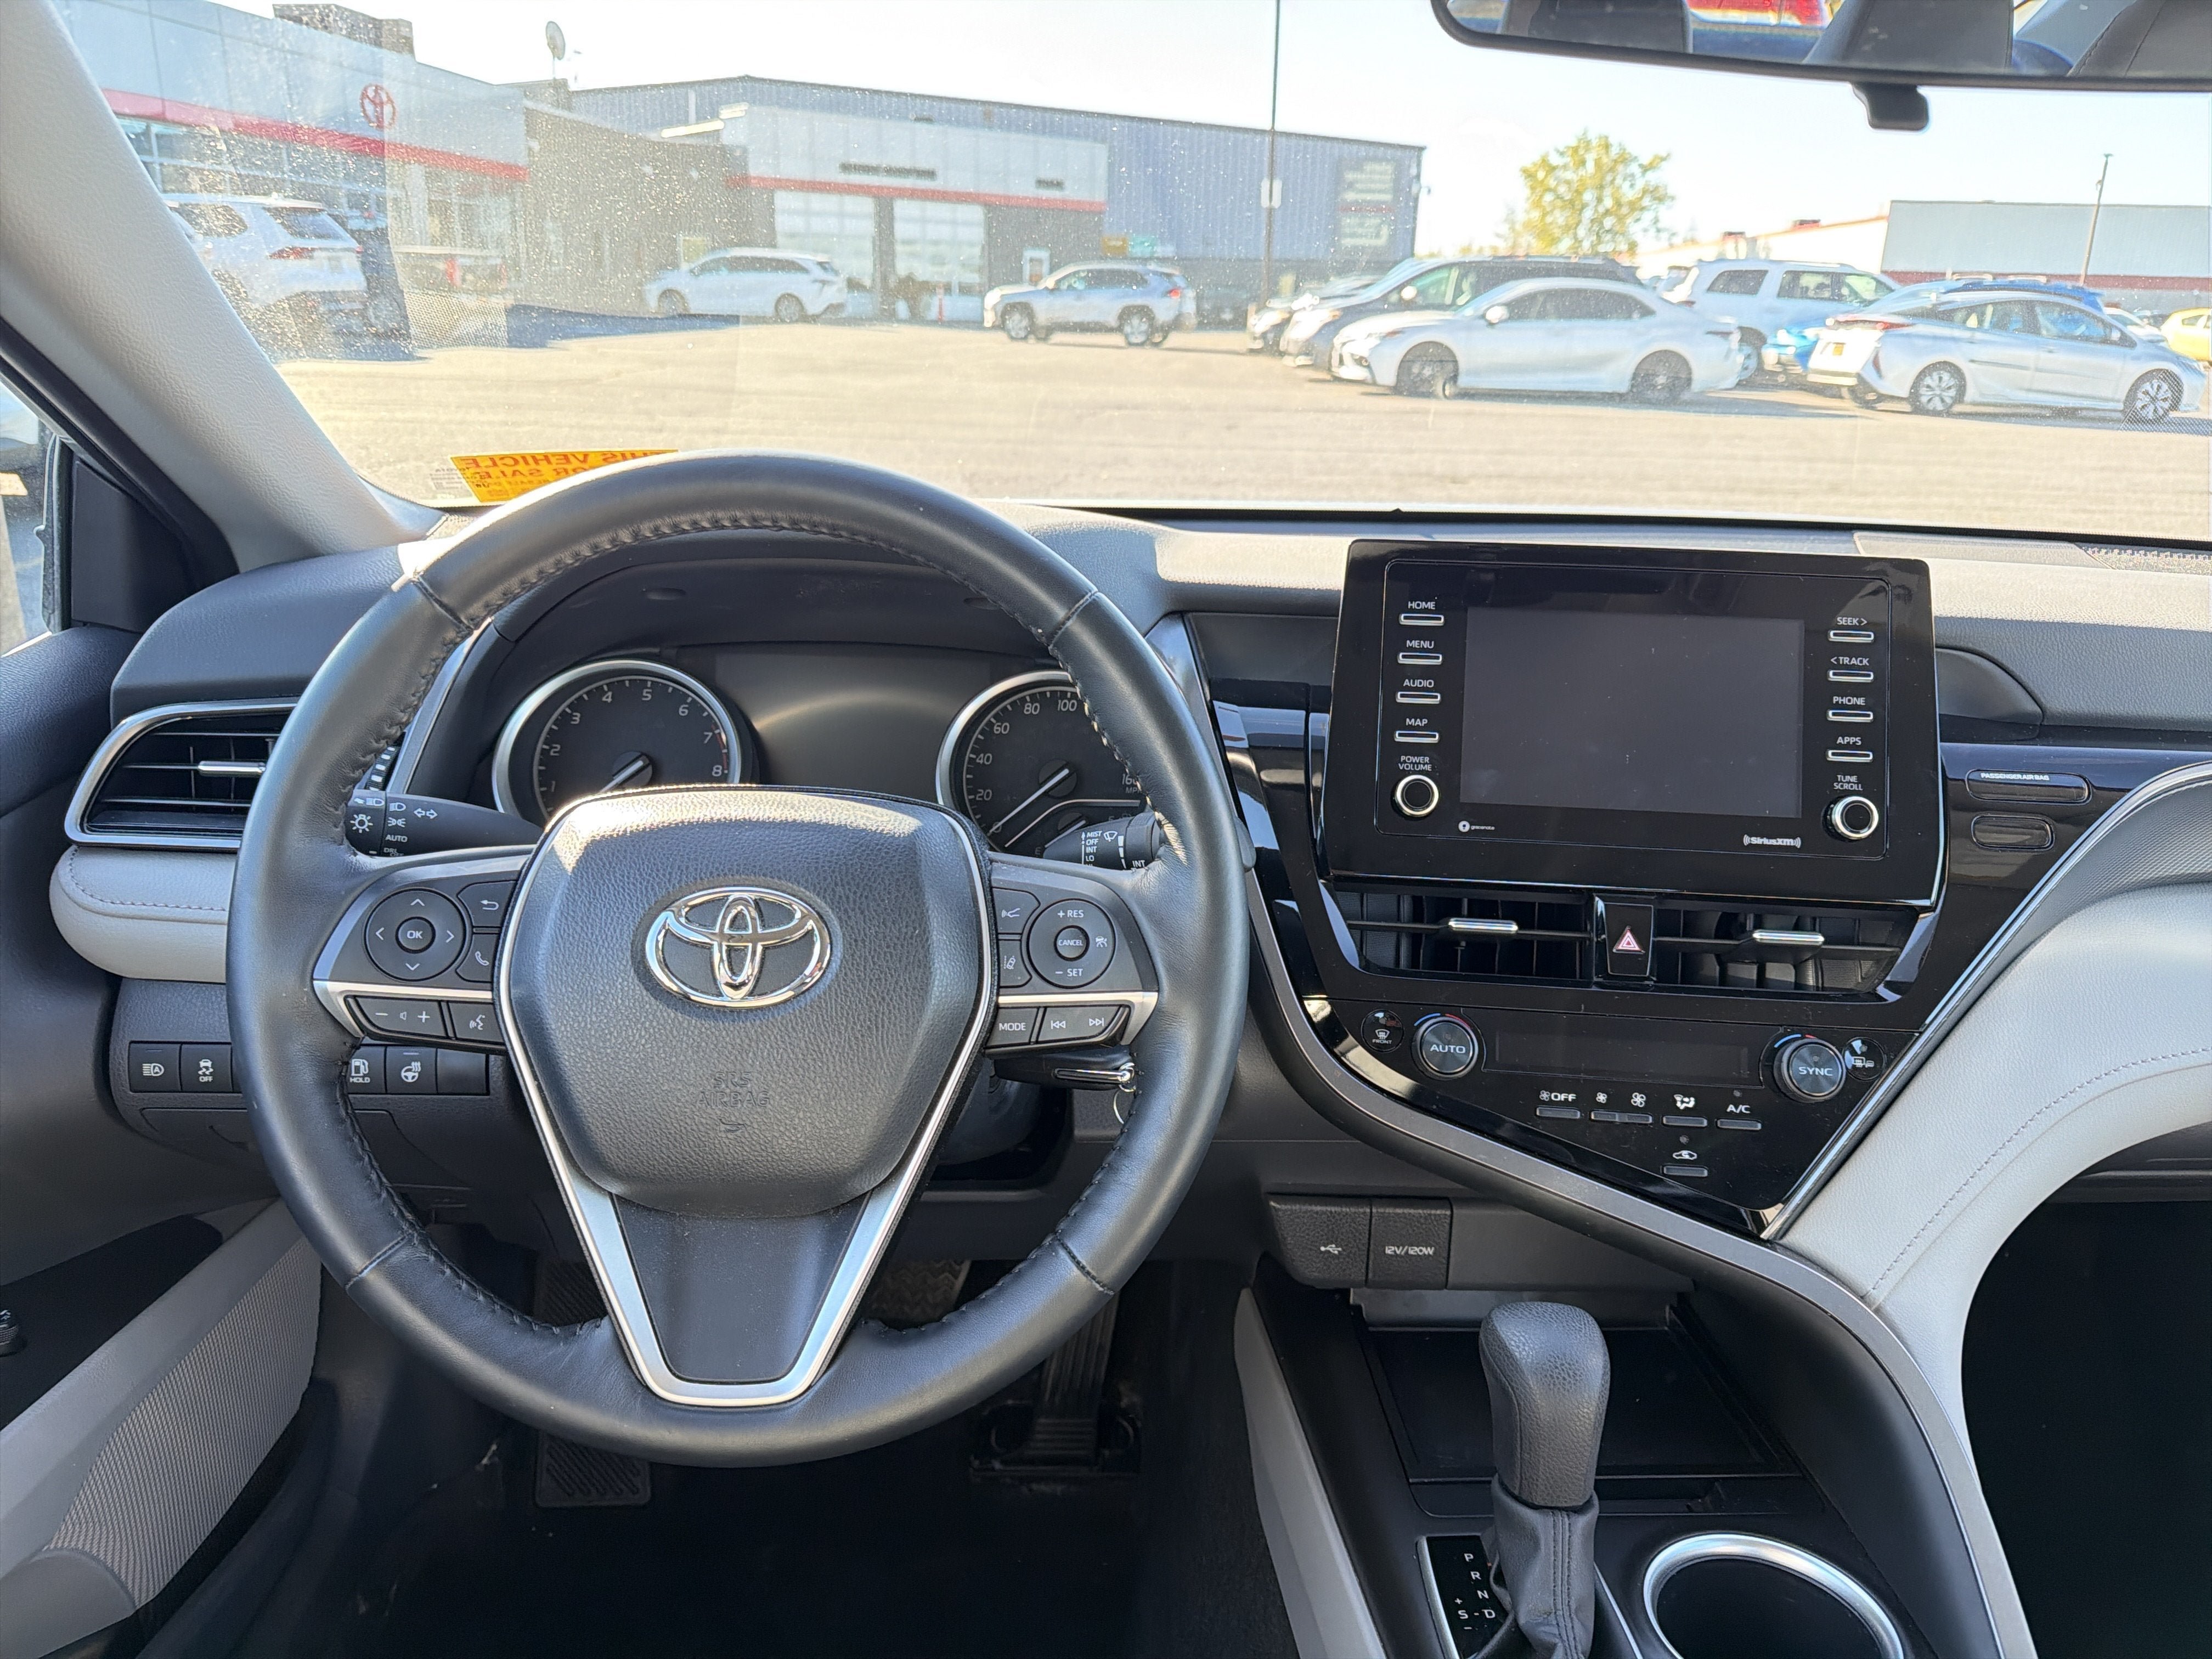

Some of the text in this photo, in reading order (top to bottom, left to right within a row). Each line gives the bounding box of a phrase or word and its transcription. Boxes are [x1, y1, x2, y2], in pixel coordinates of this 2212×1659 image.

[1408, 601, 1436, 610] HOME
[1837, 617, 1859, 625] SEEK
[1406, 640, 1434, 648] MENU
[1838, 657, 1870, 665] TRACK
[1403, 679, 1434, 687] AUDIO
[602, 691, 613, 703] 4
[642, 689, 652, 701] 5
[1057, 699, 1077, 711] 100
[1833, 696, 1866, 706] PHONE
[678, 704, 689, 716] 6
[1024, 703, 1040, 714] 80
[571, 712, 581, 725] 3
[1406, 718, 1428, 726] MAP
[994, 723, 1010, 735] 60
[703, 731, 713, 744] 7
[1836, 736, 1861, 746] APPS
[550, 744, 561, 757] 2
[975, 753, 993, 765] 40
[712, 765, 723, 777] 8
[1398, 763, 1432, 771] VOLUME
[551, 781, 556, 792] 1
[1833, 782, 1863, 791] SCROLL
[975, 789, 992, 801] 20
[385, 834, 408, 843] AUTO
[1132, 860, 1145, 868] INT
[1067, 910, 1084, 918] RES
[407, 930, 423, 939] OK
[998, 1022, 1026, 1031] MODE
[1430, 1044, 1466, 1054] AUTO
[1798, 1066, 1833, 1076] SYNC
[714, 1071, 751, 1088] SRS
[694, 1091, 769, 1107] AIRBAG
[1551, 1092, 1577, 1102] OFF
[1726, 1104, 1751, 1114] A/C
[1385, 1246, 1435, 1255] 12V/120W
[1464, 1553, 1474, 1562] P
[1470, 1571, 1482, 1580] R
[1477, 1590, 1489, 1599] N
[1458, 1610, 1496, 1619] S D
